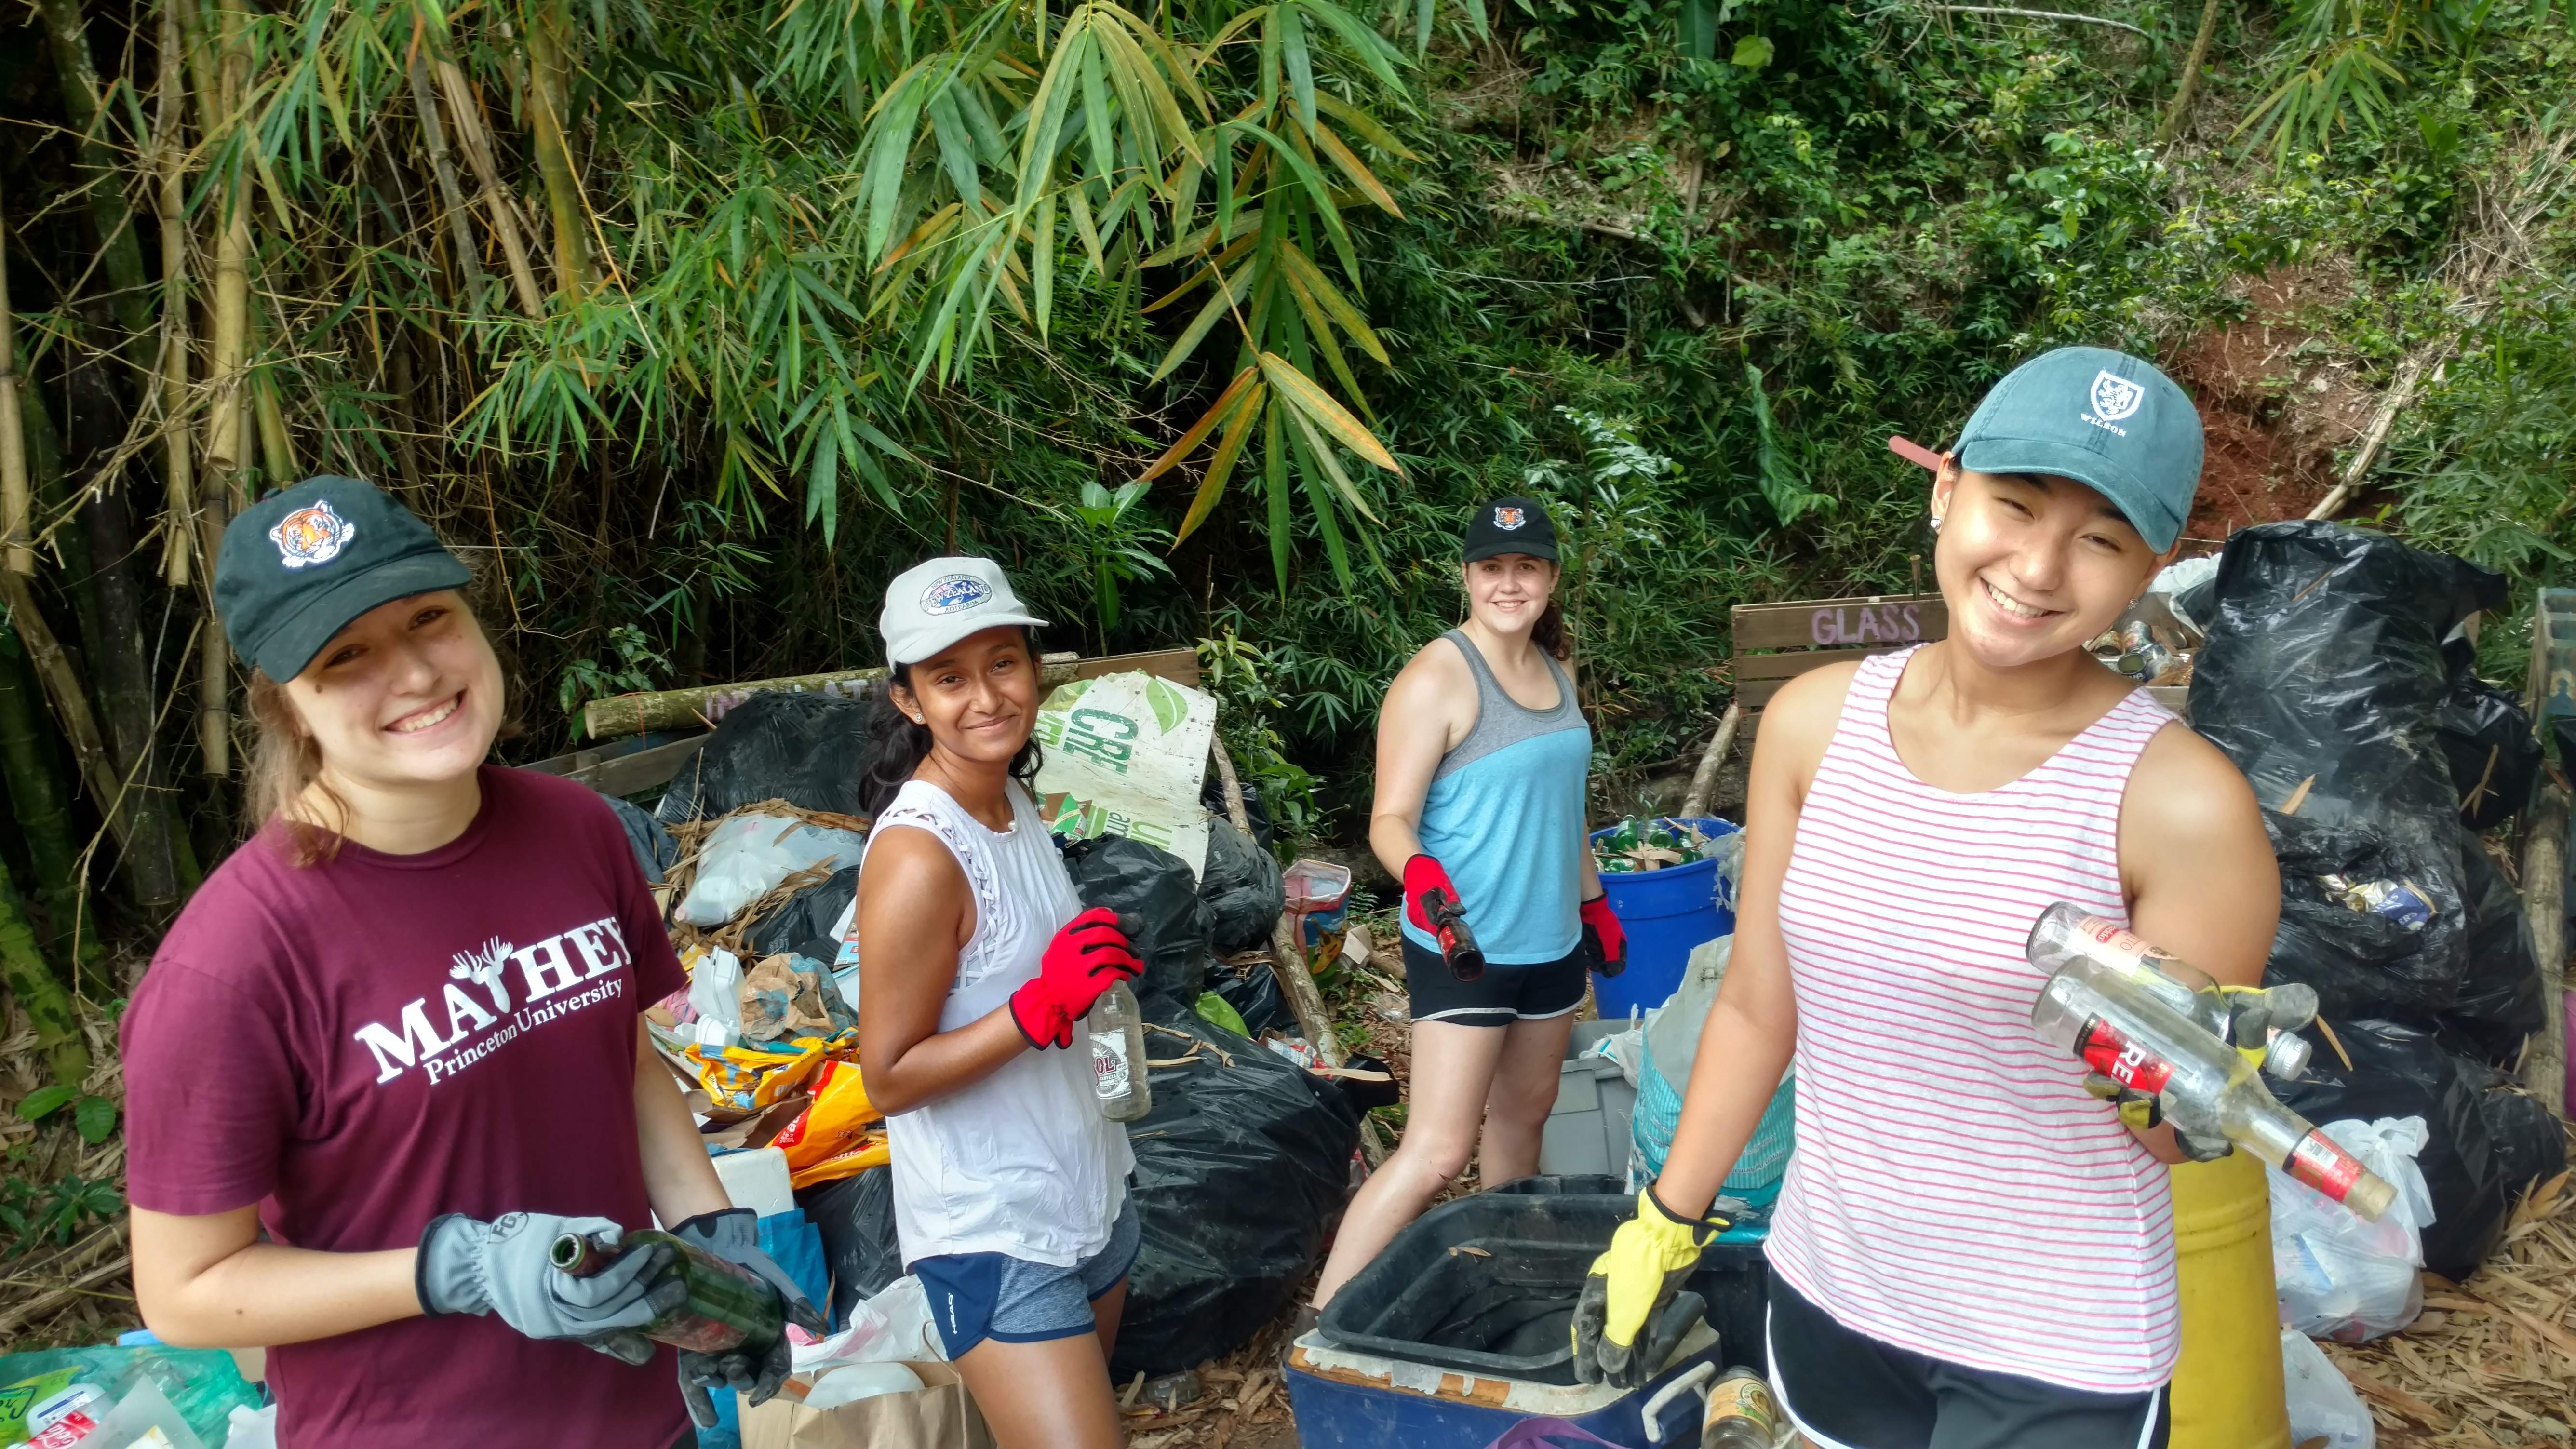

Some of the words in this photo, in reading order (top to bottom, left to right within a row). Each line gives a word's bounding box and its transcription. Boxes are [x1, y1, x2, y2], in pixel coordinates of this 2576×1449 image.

[2080, 413, 2127, 437] WILSON
[921, 592, 944, 612] NEW
[945, 584, 990, 598] ZEALAND
[945, 601, 979, 613] AOTEAROA
[1811, 604, 1919, 644] GLASS
[423, 1026, 517, 1085] Princeton
[514, 979, 622, 1033] University
[1731, 1162, 1764, 1174] Performan
[1766, 1149, 1784, 1164] Proven
[949, 1293, 957, 1334] HEAD
